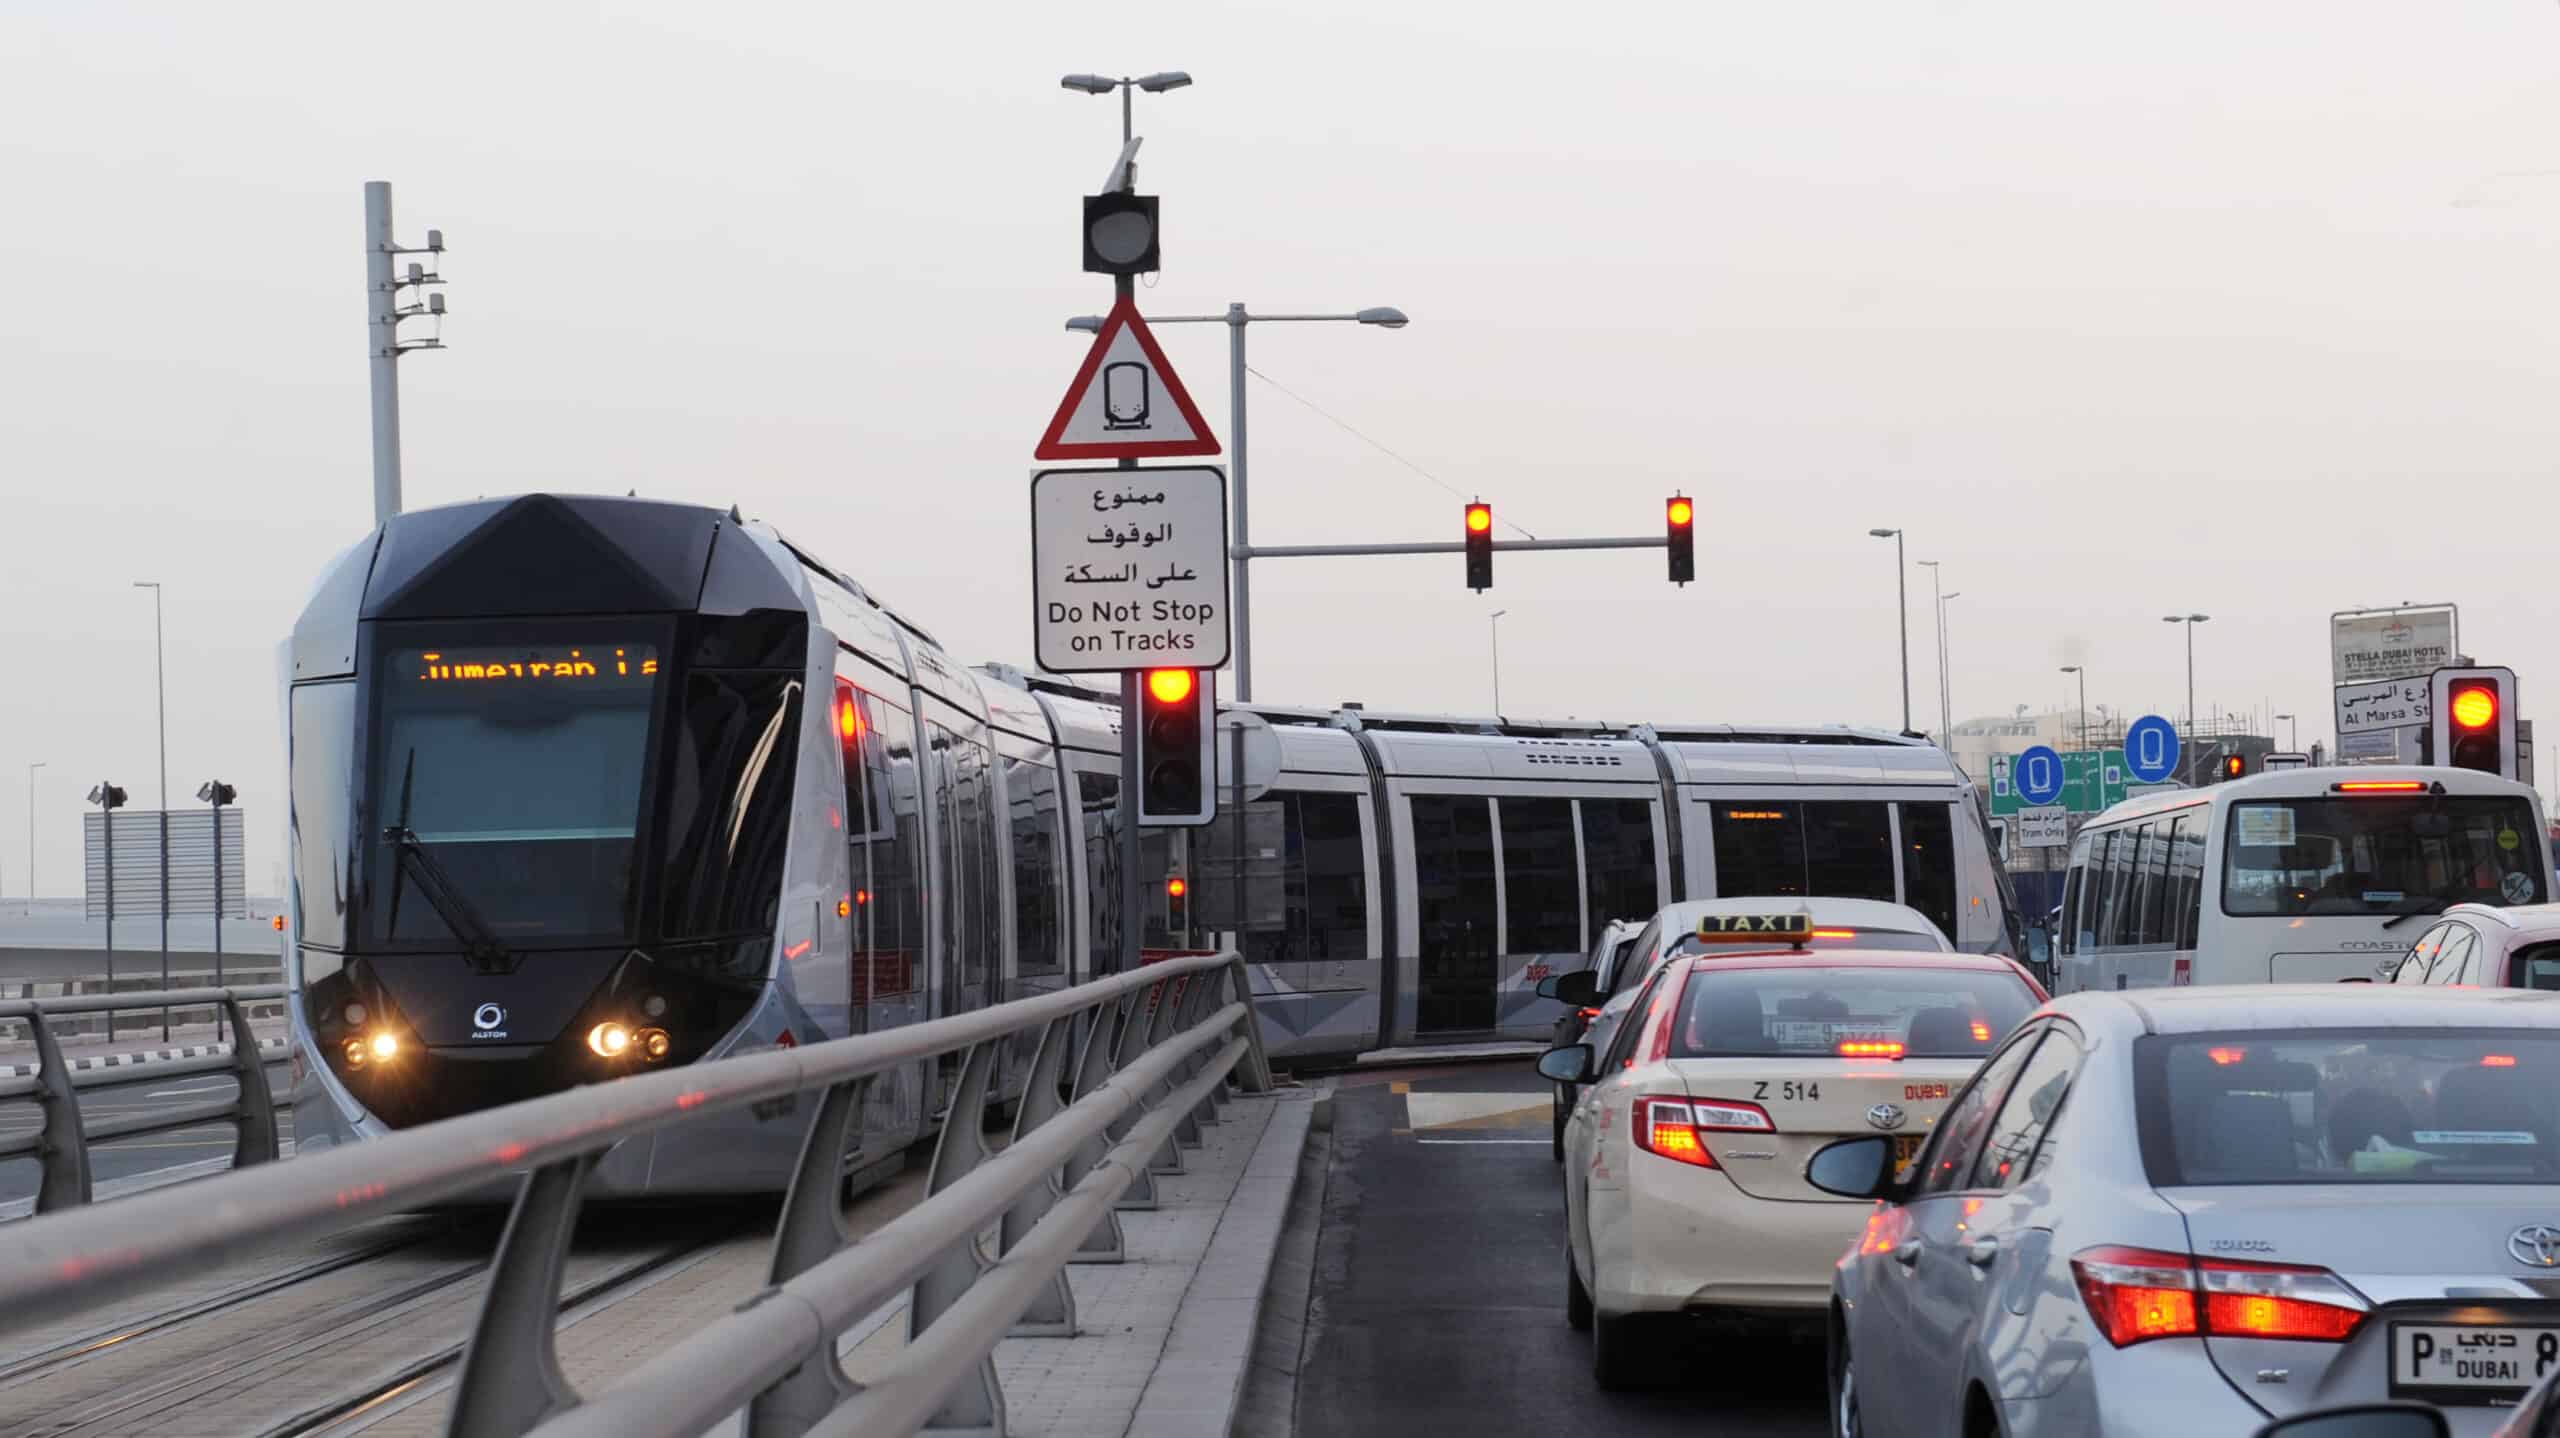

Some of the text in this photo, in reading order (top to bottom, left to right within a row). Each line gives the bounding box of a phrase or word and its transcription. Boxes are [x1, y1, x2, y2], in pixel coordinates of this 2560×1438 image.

[1093, 486, 1165, 512] ممنوع
[1087, 522, 1172, 548] الوقوف
[1064, 562, 1198, 589] على السكة
[1049, 600, 1214, 625] Do Not Stop
[1071, 629, 1195, 651] on Tracks
[2344, 651, 2380, 663] STELLA
[2382, 648, 2412, 659] DUBAI
[2414, 647, 2447, 657] HOTEL
[2345, 712, 2359, 725] Al
[2366, 710, 2406, 722] Marsa
[1714, 915, 1793, 931] TAXI
[1754, 1081, 1820, 1101] Z 514
[1904, 1084, 1950, 1101] DUBAI
[2412, 1332, 2434, 1377] P
[2456, 1360, 2518, 1379] DUBAI
